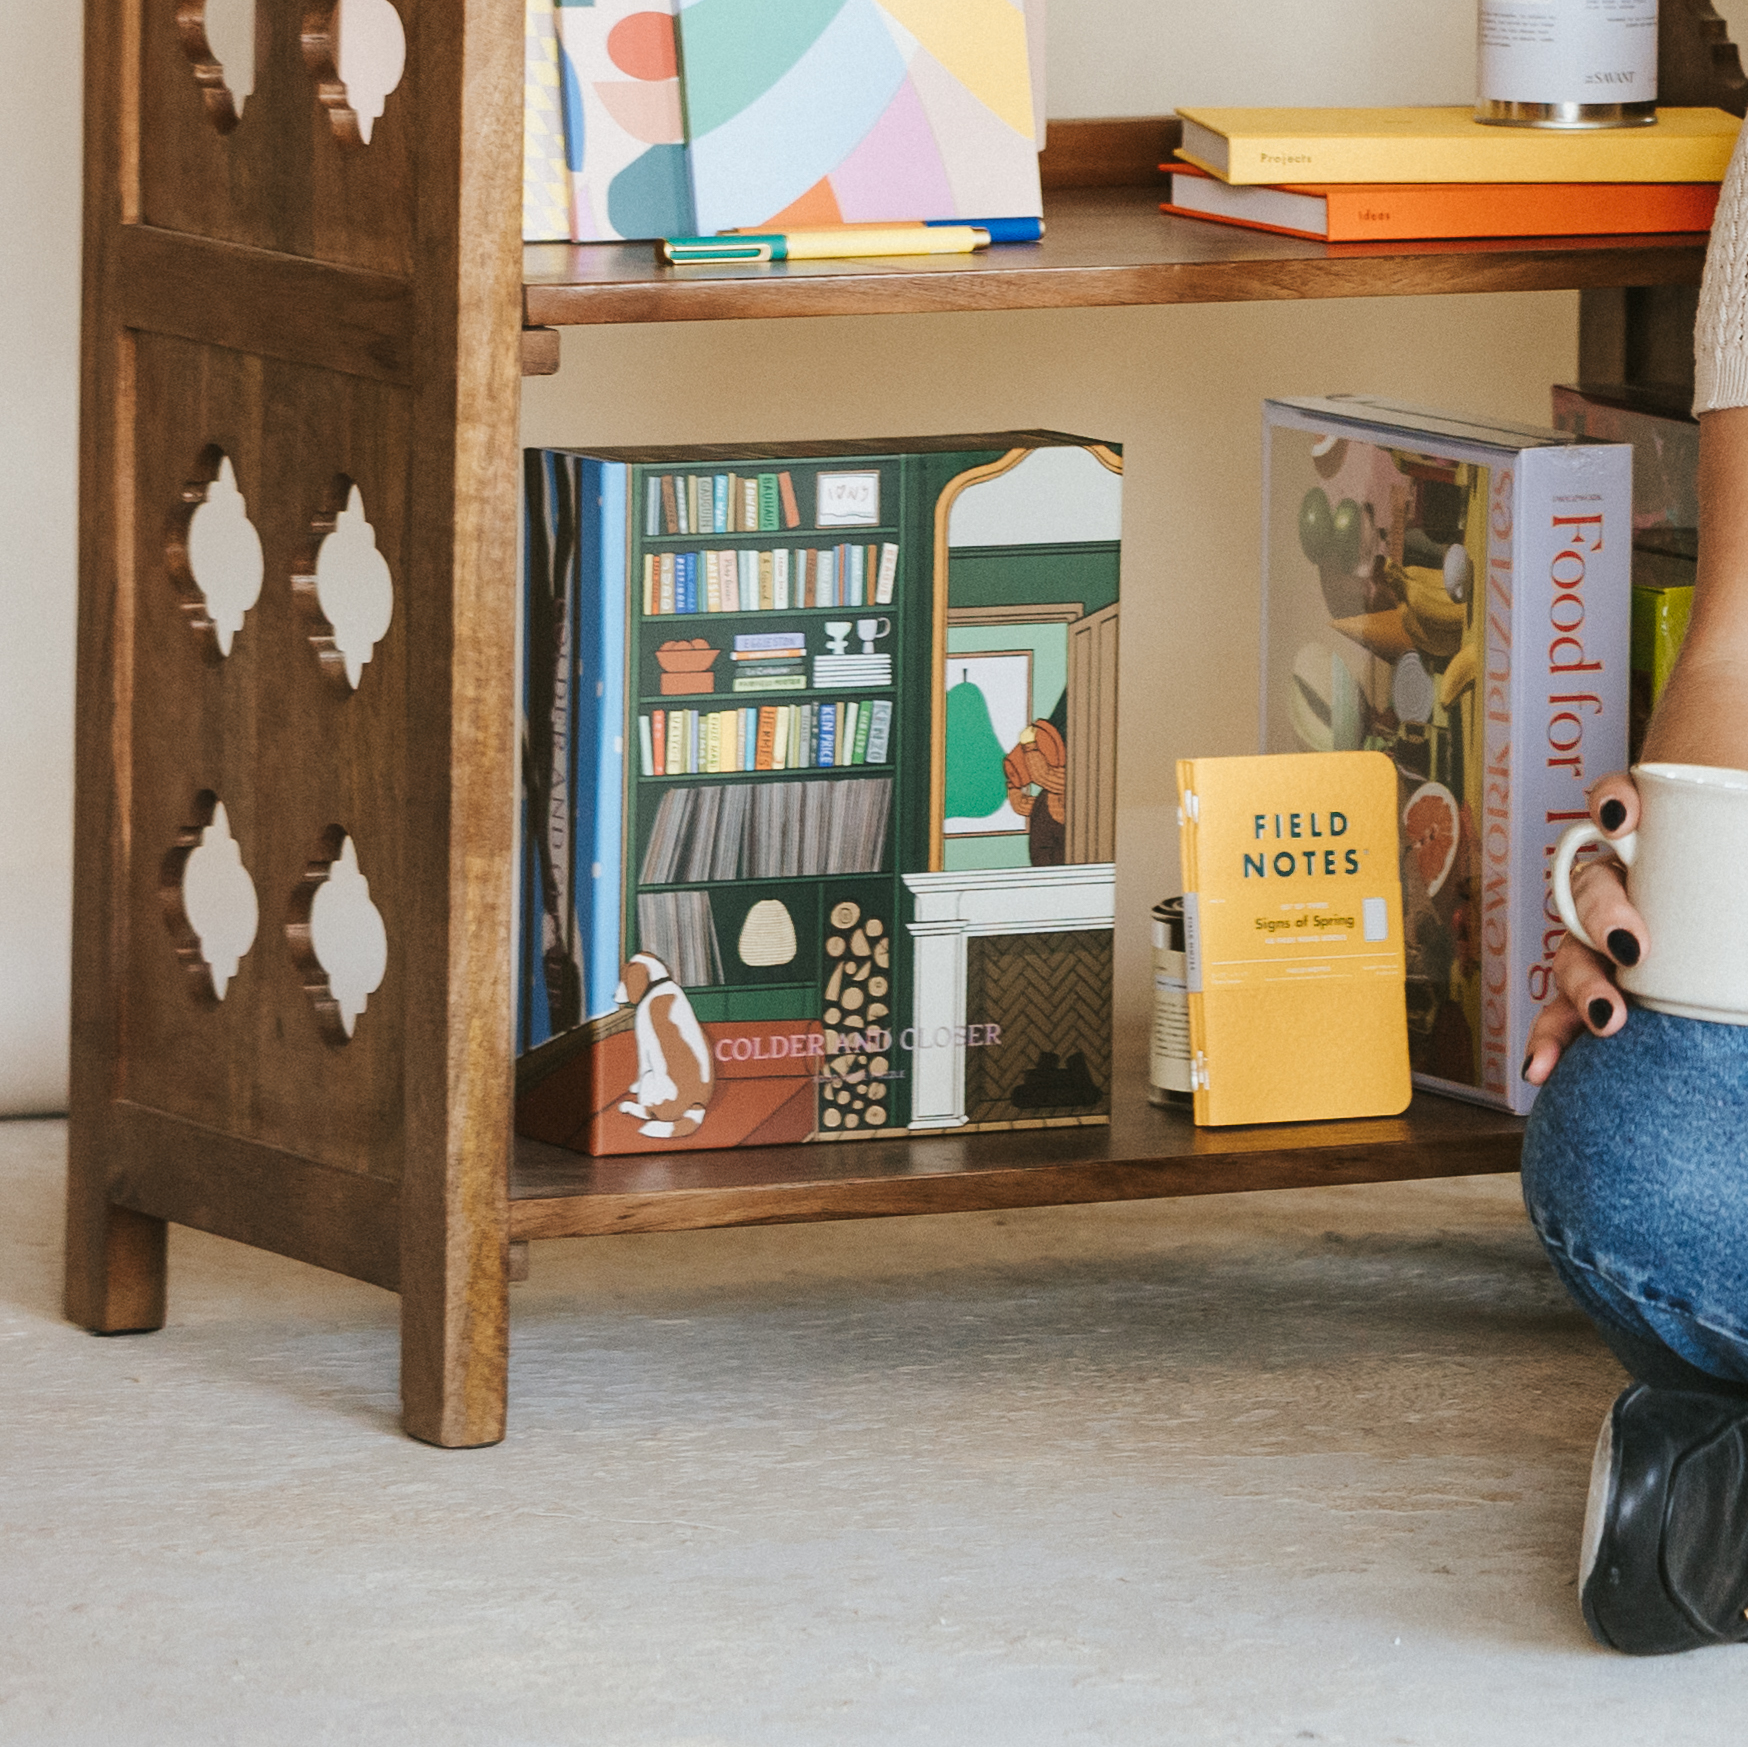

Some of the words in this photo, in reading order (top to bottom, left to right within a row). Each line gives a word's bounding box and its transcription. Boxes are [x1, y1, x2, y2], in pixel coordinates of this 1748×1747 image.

[1259, 151, 1313, 168] Projects
[1357, 209, 1391, 223] Ideas
[762, 476, 777, 530] BAUHAUS
[1549, 513, 1604, 674] Food
[820, 705, 835, 731] KEN
[819, 732, 834, 767] PRICE
[1546, 692, 1605, 780] for
[1254, 811, 1350, 840] FIELD
[1242, 848, 1361, 879] NOTES
[1255, 917, 1291, 933] Signs
[1313, 913, 1356, 931] Spring
[714, 1033, 826, 1063] COLDER
[899, 1022, 1003, 1051] CLOSER
